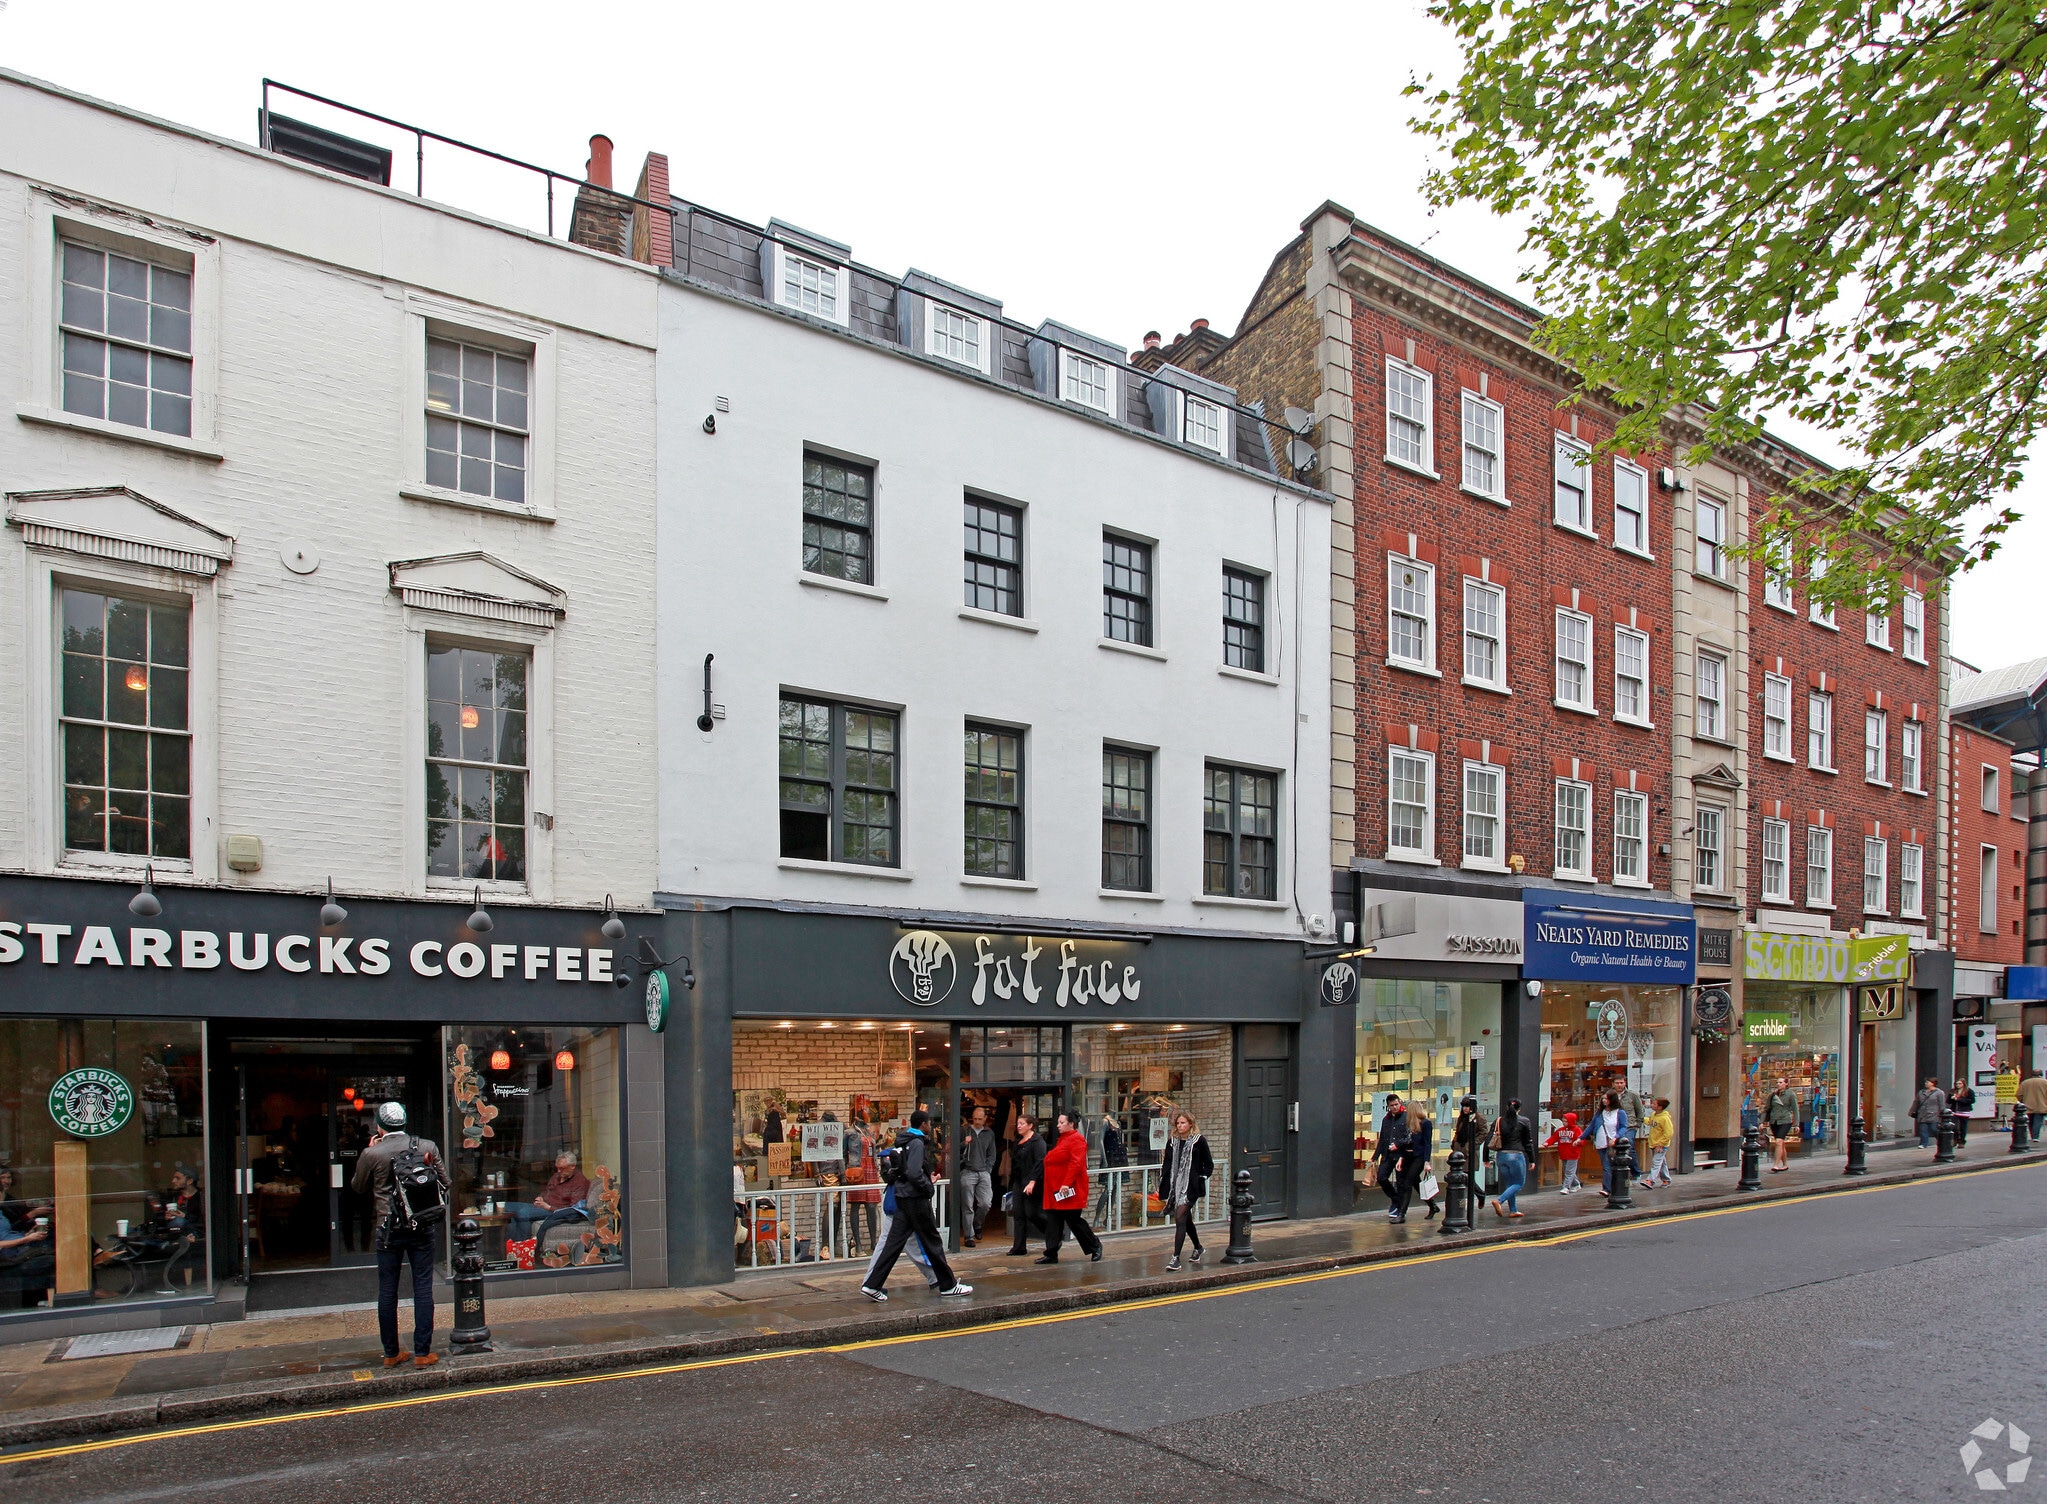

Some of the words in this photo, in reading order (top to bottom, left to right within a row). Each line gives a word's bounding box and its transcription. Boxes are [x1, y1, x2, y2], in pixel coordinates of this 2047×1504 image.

[1535, 922, 1583, 945] NEAL'S
[1585, 926, 1622, 947] YARD
[1625, 930, 1689, 951] REMEDIES
[1703, 934, 1727, 946] MITRE
[0, 921, 392, 976] STARBUCKS
[409, 940, 614, 983] COFFEE
[1571, 951, 1600, 967] Organic
[1601, 953, 1629, 966] Natural
[1630, 954, 1653, 967] Health
[1654, 956, 1663, 967] &
[1663, 957, 1687, 970] Beauty
[1703, 947, 1727, 959] HOUSE
[1858, 940, 1899, 977] scribbler
[971, 935, 1043, 1006] fat
[1055, 939, 1141, 1008] face
[1749, 1018, 1788, 1037] scribbler
[53, 1071, 129, 1102] STARBUCKS
[60, 1114, 119, 1134] COFFEE
[823, 1124, 840, 1132] WIN
